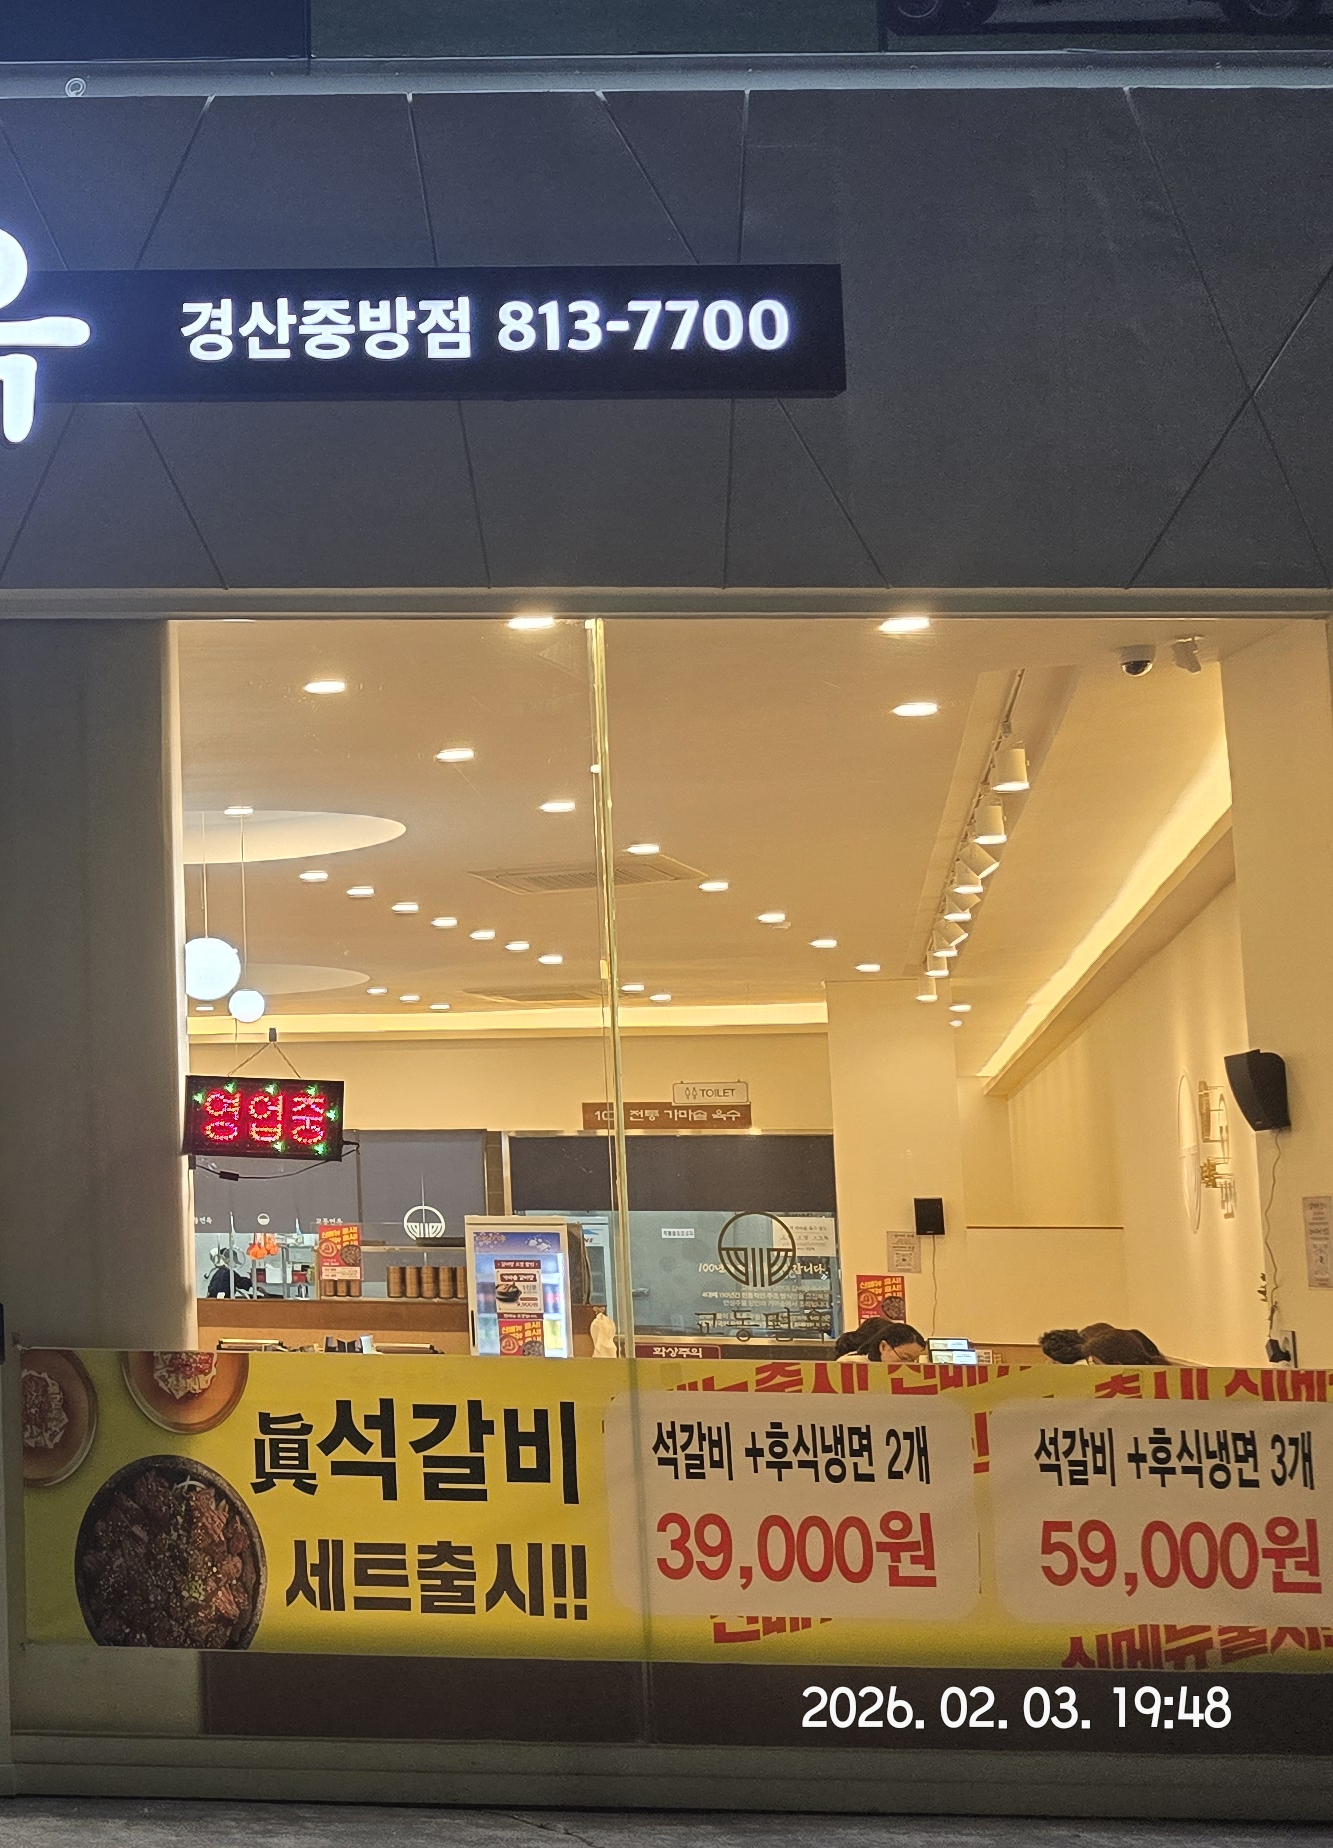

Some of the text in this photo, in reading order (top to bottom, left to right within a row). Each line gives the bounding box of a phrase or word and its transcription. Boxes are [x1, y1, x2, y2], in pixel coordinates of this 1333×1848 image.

[179, 295, 791, 364] 경산중방점 813-7700
[204, 1088, 327, 1144] 영업중
[629, 1109, 659, 1122] 전통
[699, 1087, 736, 1098] TOILET
[652, 1346, 703, 1359] 화상주의
[652, 1420, 931, 1485] 석갈비 +후식냉면 2개
[1034, 1426, 1315, 1490] 석갈비 +후식냉면 3개
[285, 1538, 589, 1621] 세트출시!!
[656, 1510, 938, 1591] 39,000원
[1040, 1515, 1323, 1597] 59,000원
